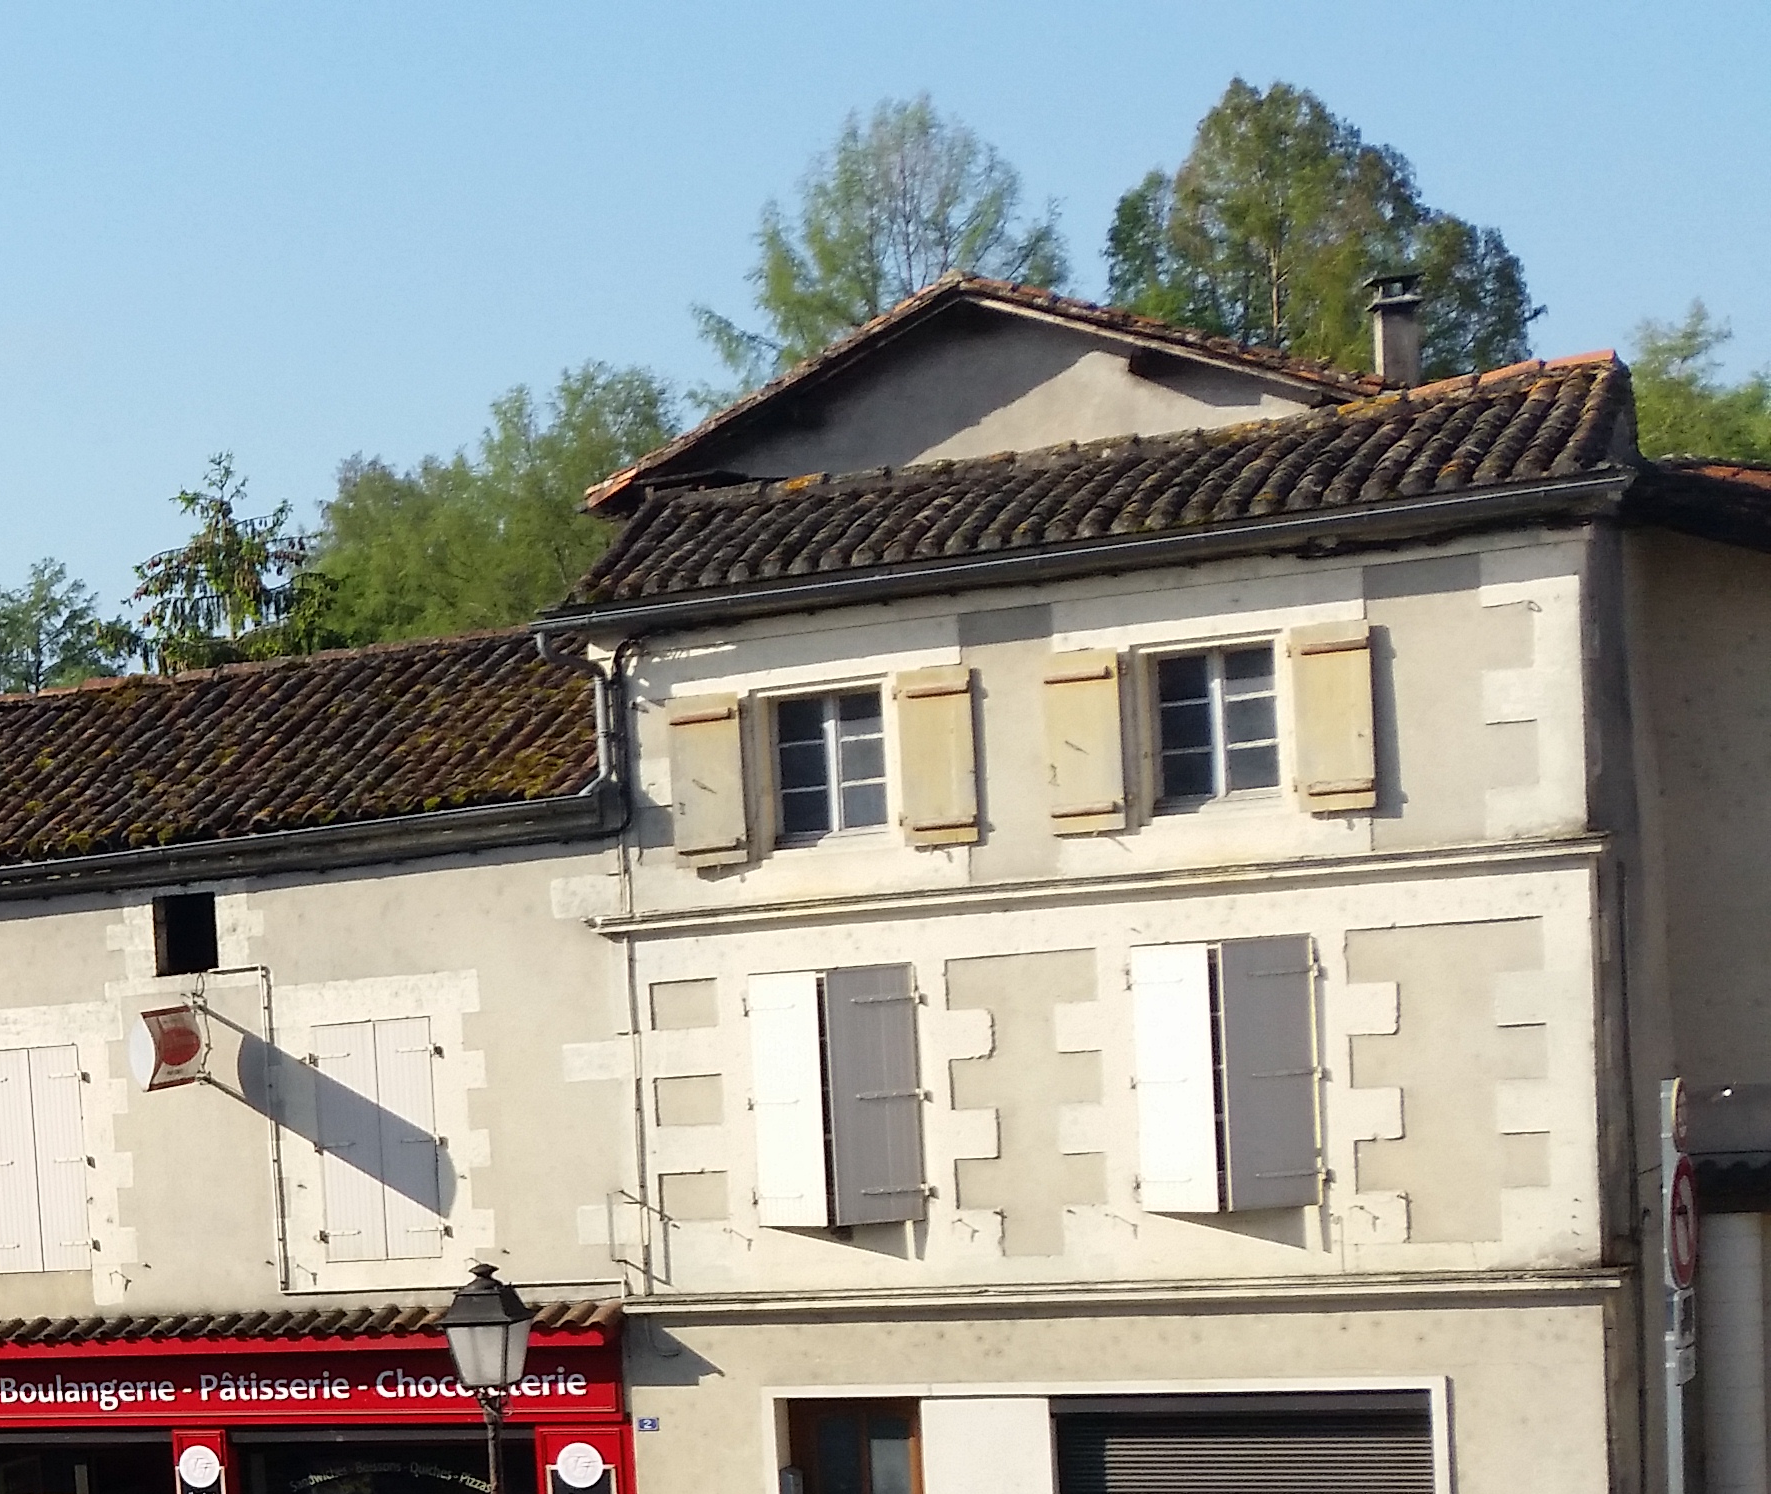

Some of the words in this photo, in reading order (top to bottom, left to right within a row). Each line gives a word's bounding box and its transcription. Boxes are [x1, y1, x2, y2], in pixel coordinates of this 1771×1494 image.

[0, 1374, 176, 1411] Boulangerie
[199, 1370, 351, 1401] Pâtisserie
[289, 1466, 348, 1493] Sandwiches
[459, 1471, 492, 1494] Pizzas
